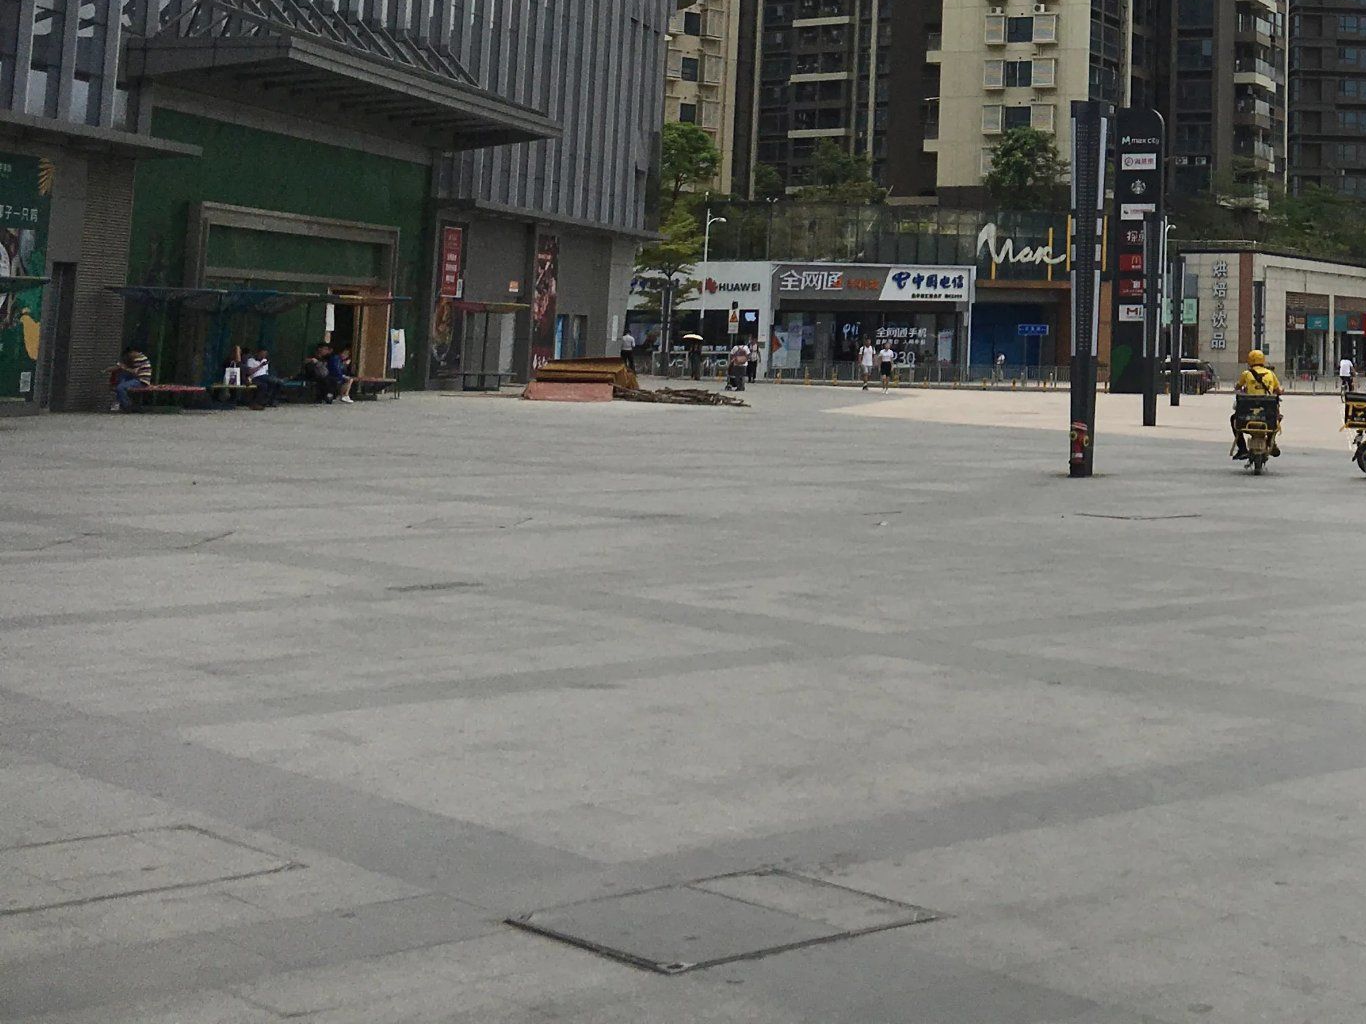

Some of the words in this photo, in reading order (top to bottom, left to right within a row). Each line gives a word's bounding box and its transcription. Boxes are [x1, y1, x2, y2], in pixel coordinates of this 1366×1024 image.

[718, 282, 761, 292] HUAWEI
[779, 270, 843, 291] 全网通
[912, 273, 964, 290] 中国电信
